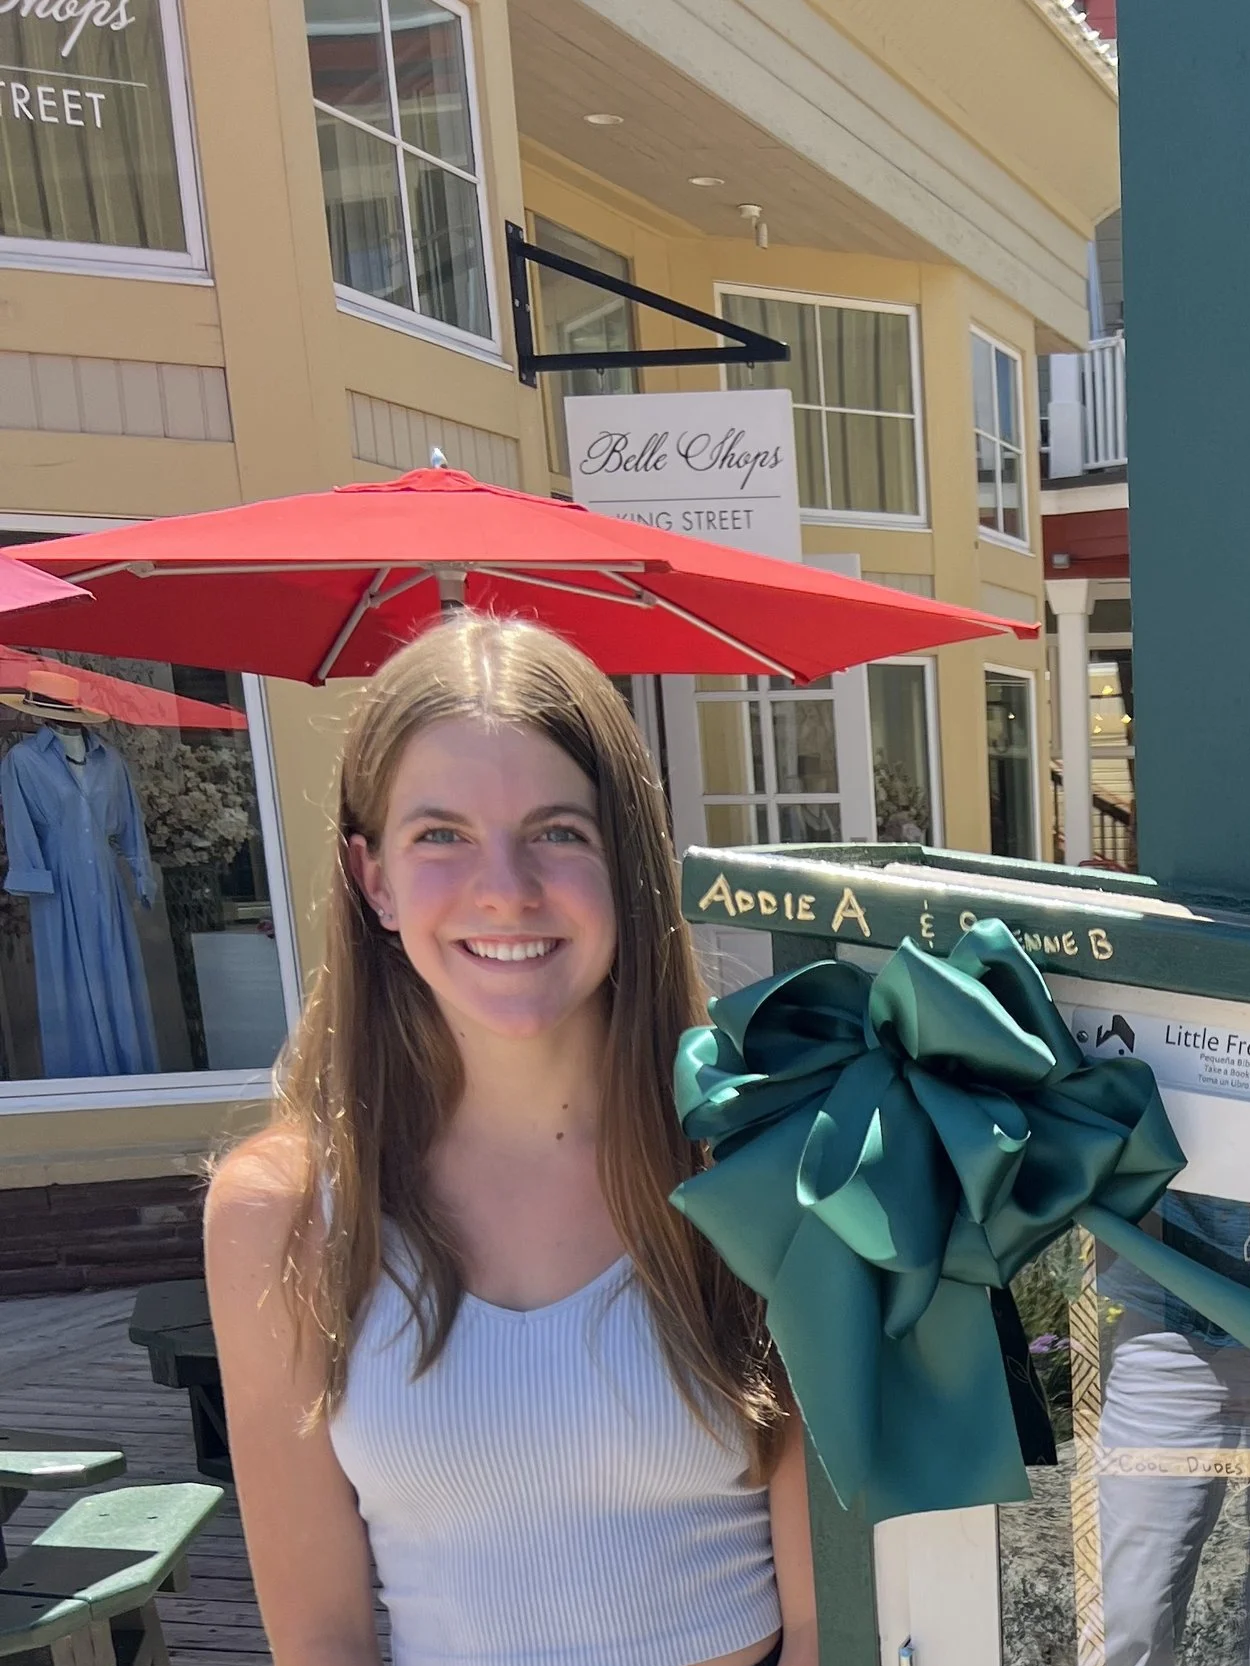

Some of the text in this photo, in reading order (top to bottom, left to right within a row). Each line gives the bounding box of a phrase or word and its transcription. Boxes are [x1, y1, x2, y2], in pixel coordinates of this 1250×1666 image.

[0, 0, 136, 57] ops
[0, 81, 106, 129] REET
[580, 428, 784, 490] Belle Shops
[682, 510, 754, 531] STREET
[699, 872, 816, 922] ADDIE
[830, 887, 871, 938] A
[1088, 928, 1114, 961] B
[1165, 1024, 1219, 1051] Little
[1199, 1052, 1235, 1066] Pequeña
[1198, 1074, 1218, 1085] Toma
[1219, 1077, 1229, 1086] un
[1204, 1064, 1223, 1075] Take
[1230, 1068, 1250, 1079] Book
[1118, 1453, 1168, 1473] COOL
[1186, 1456, 1243, 1475] DUDES
